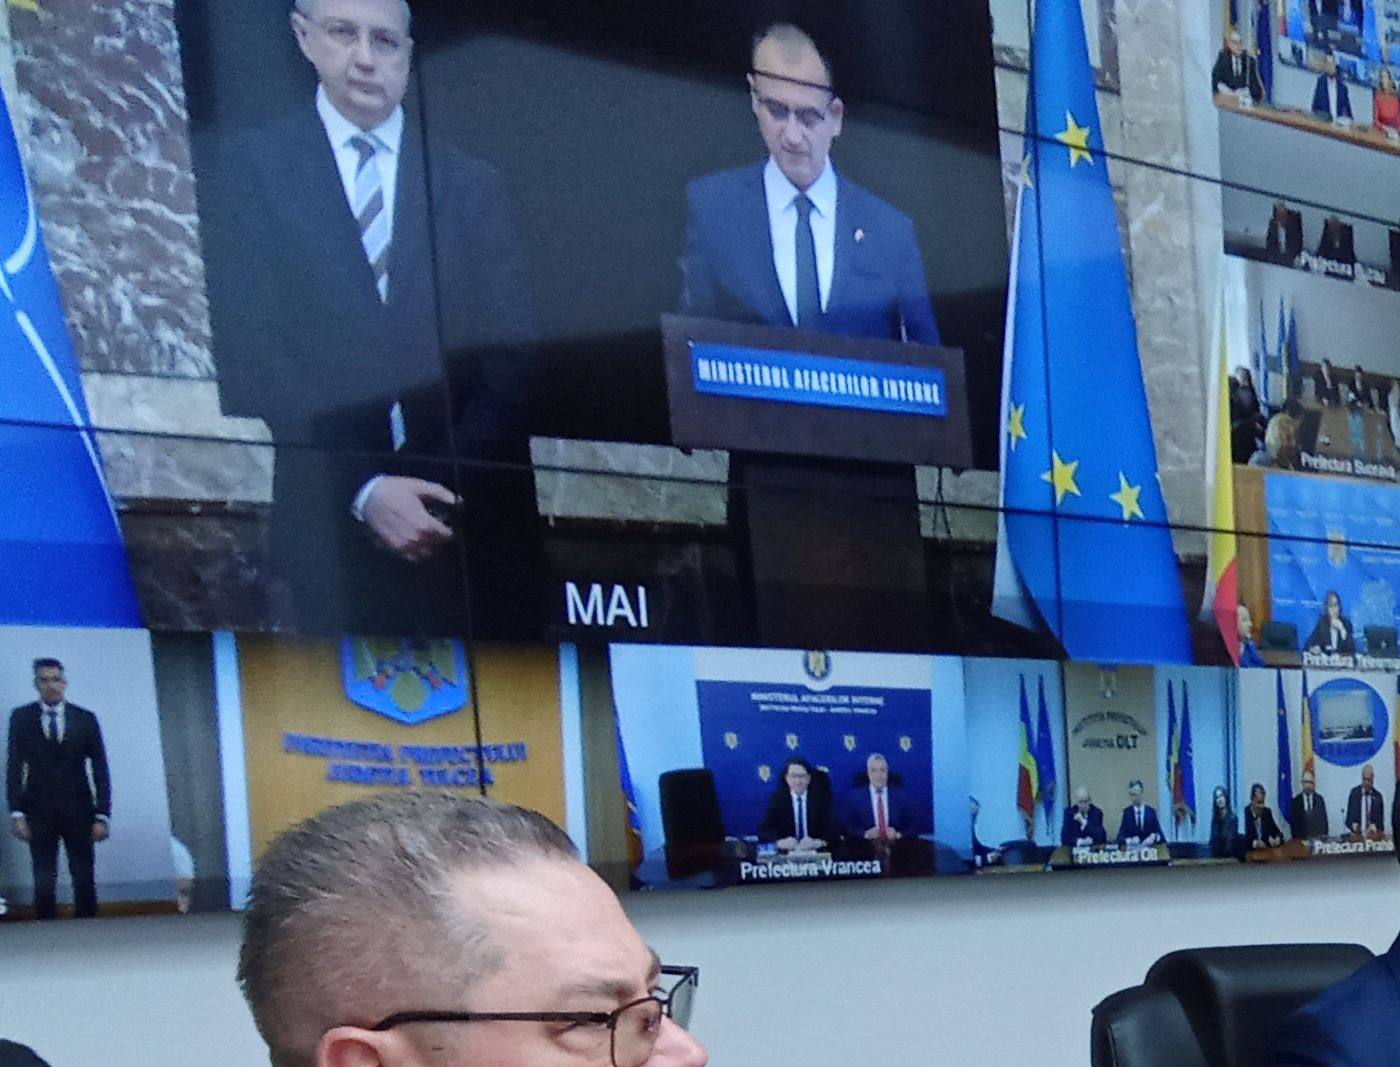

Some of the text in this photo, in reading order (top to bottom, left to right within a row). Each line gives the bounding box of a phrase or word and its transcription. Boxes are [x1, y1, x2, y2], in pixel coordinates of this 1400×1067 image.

[565, 581, 649, 628] MAI
[1078, 849, 1139, 865] Prefectura
[740, 859, 882, 880] Prefectura Vrancea
